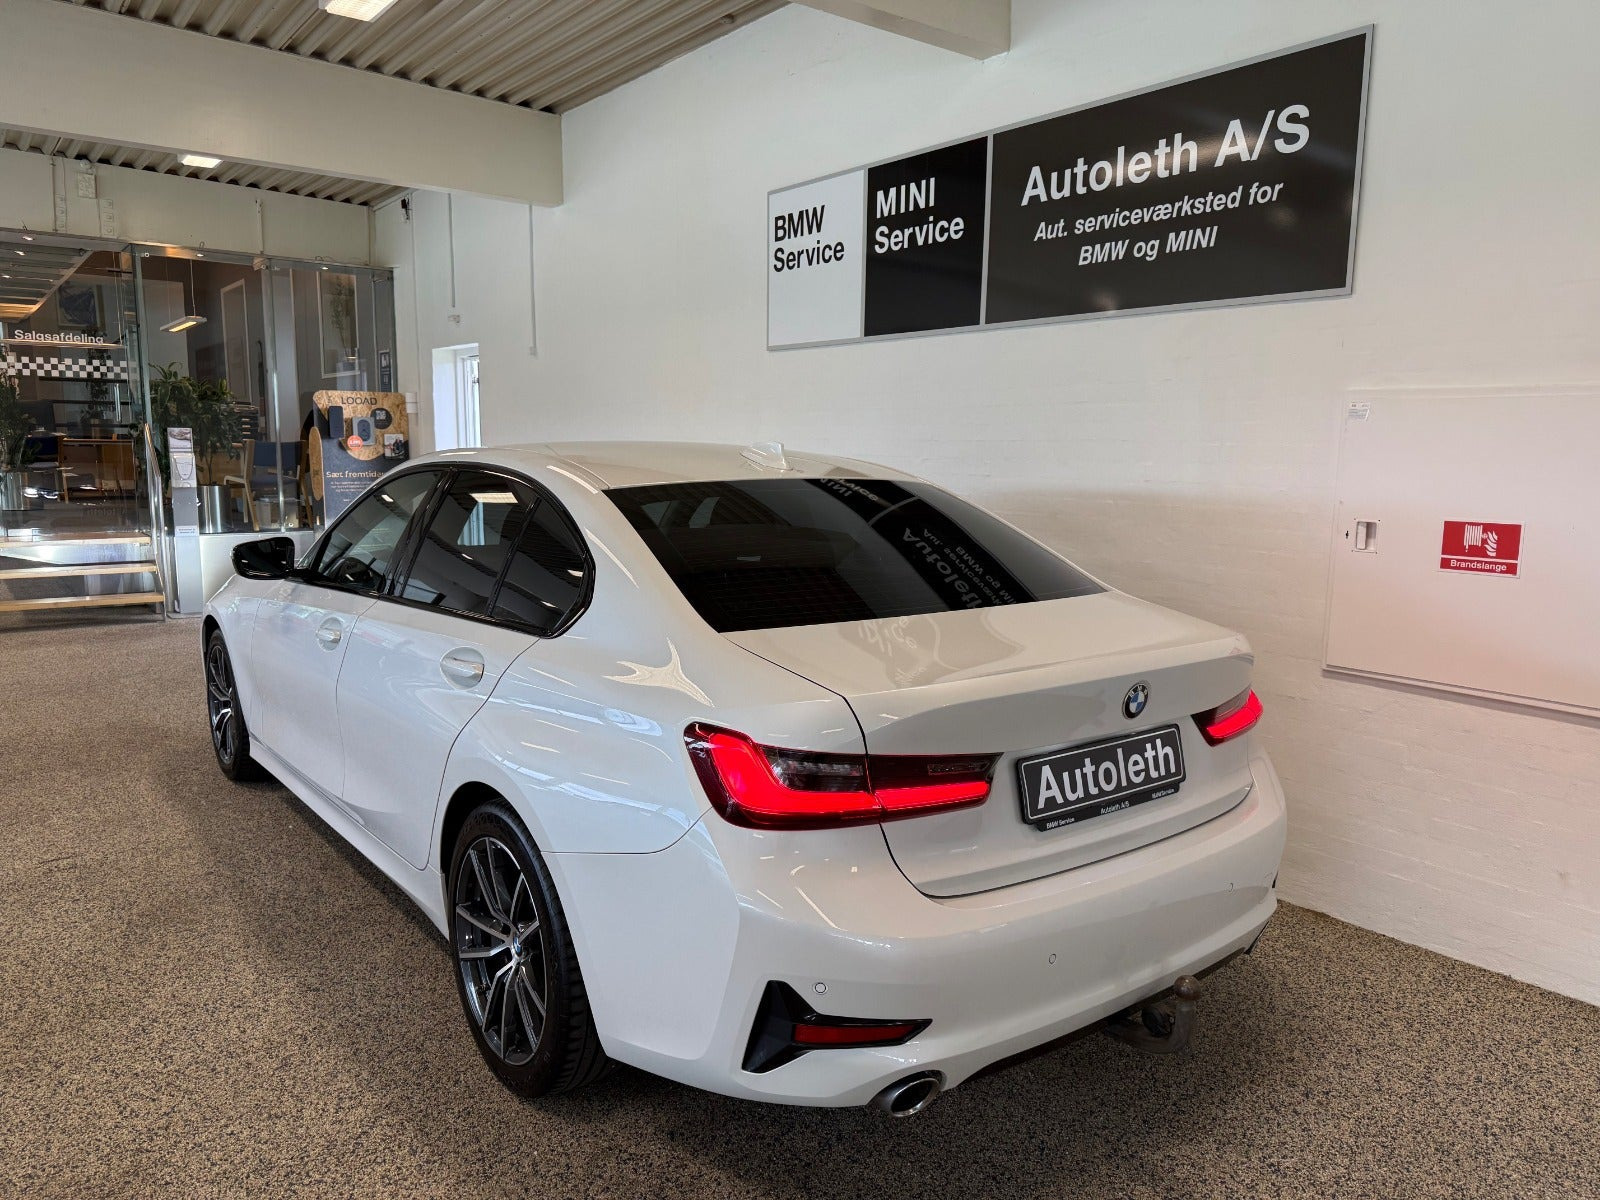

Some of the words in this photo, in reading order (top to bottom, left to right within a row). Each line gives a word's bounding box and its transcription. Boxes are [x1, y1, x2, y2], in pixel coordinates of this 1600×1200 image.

[1021, 132, 1199, 206] Autoleth
[1215, 104, 1311, 167] A/S
[875, 177, 937, 219] MINI
[1034, 218, 1069, 242] Aut.
[1074, 188, 1241, 235] serviceværksted
[1248, 180, 1284, 210] for
[774, 205, 825, 243] BMW
[874, 215, 965, 254] Service
[773, 240, 845, 273] Service
[1078, 241, 1128, 266] BMW
[1133, 239, 1160, 262] og
[1165, 226, 1218, 254] MINI
[14, 329, 104, 344] Salgsafdeling
[1450, 559, 1508, 573] Brandslange
[1037, 738, 1177, 810] Autoleth
[1046, 820, 1059, 829] BMW
[1059, 817, 1075, 826] Service
